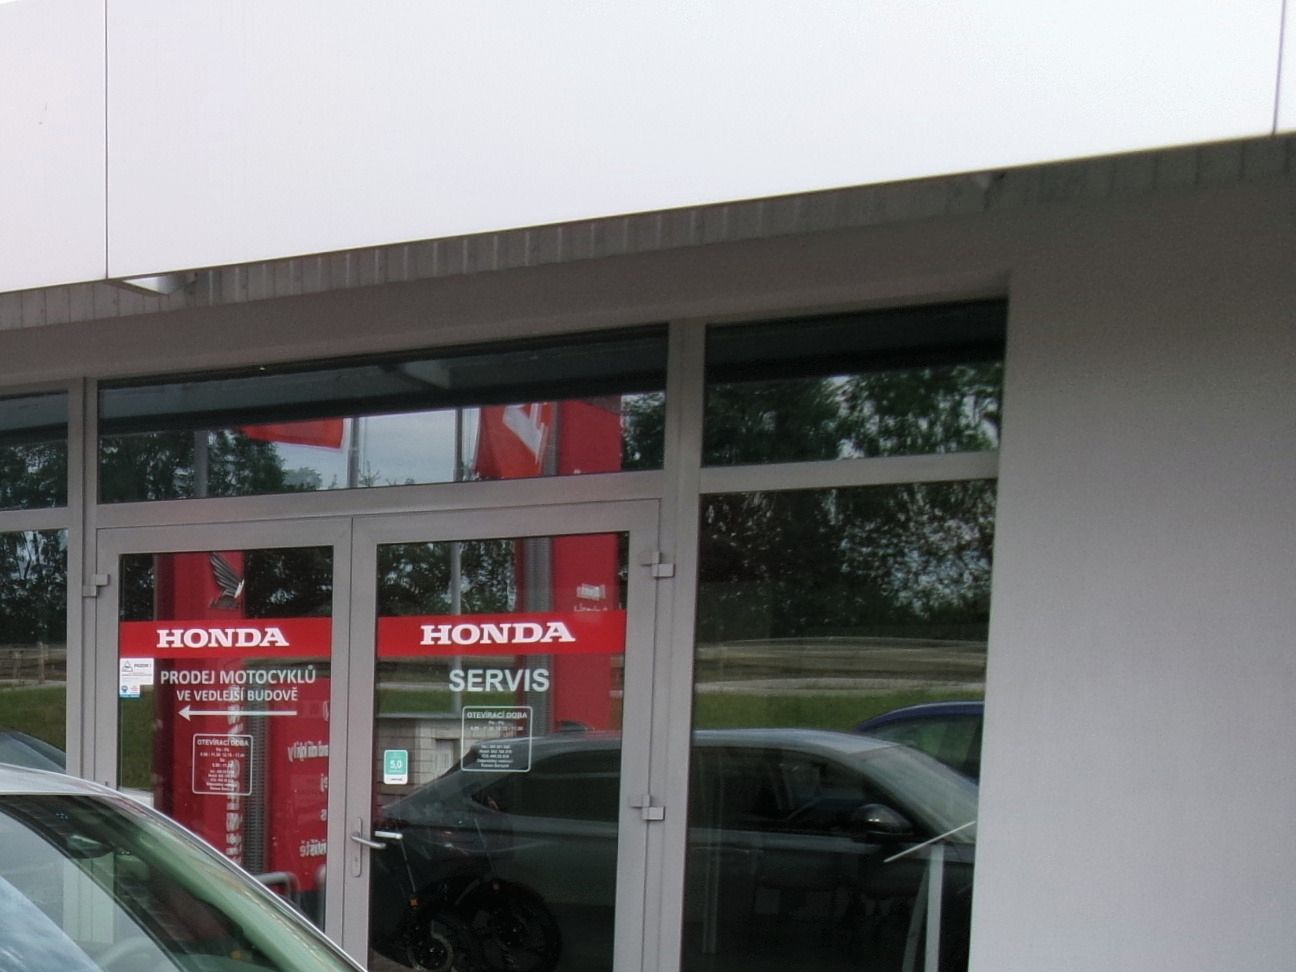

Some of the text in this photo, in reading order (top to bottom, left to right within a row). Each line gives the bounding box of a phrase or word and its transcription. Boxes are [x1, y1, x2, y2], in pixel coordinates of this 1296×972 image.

[156, 627, 290, 648] HONDA
[420, 621, 576, 646] HONDA
[160, 670, 215, 685] PRODEJ
[219, 664, 317, 685] MOTOCYKLŮ
[448, 668, 550, 692] SERVIS
[176, 687, 299, 702] VE VEDLEJŠÍ BUDOVĚ
